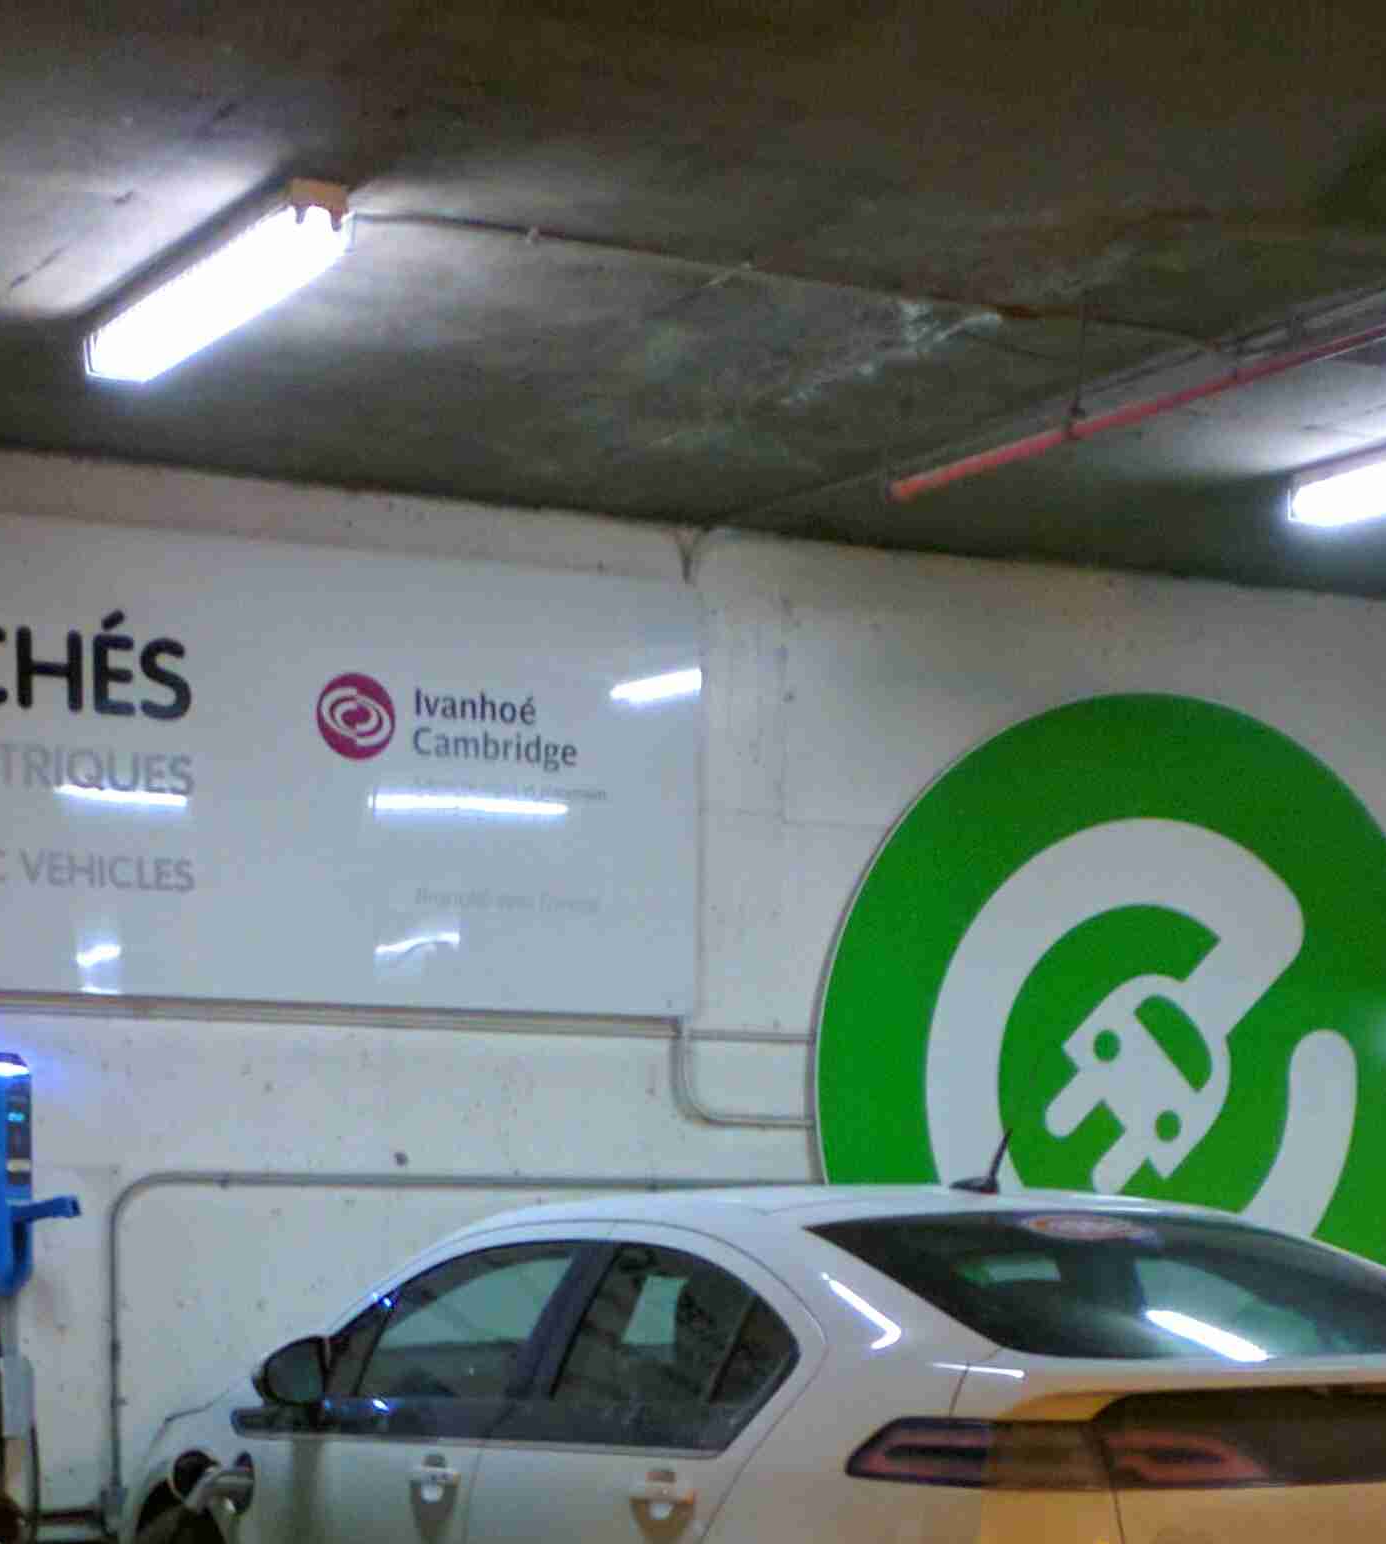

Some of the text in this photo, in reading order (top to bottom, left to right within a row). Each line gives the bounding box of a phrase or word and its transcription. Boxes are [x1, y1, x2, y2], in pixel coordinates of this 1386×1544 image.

[414, 687, 537, 726] Ivanhoé
[412, 727, 578, 773] Cambridge
[17, 850, 196, 894] VEHICLES
